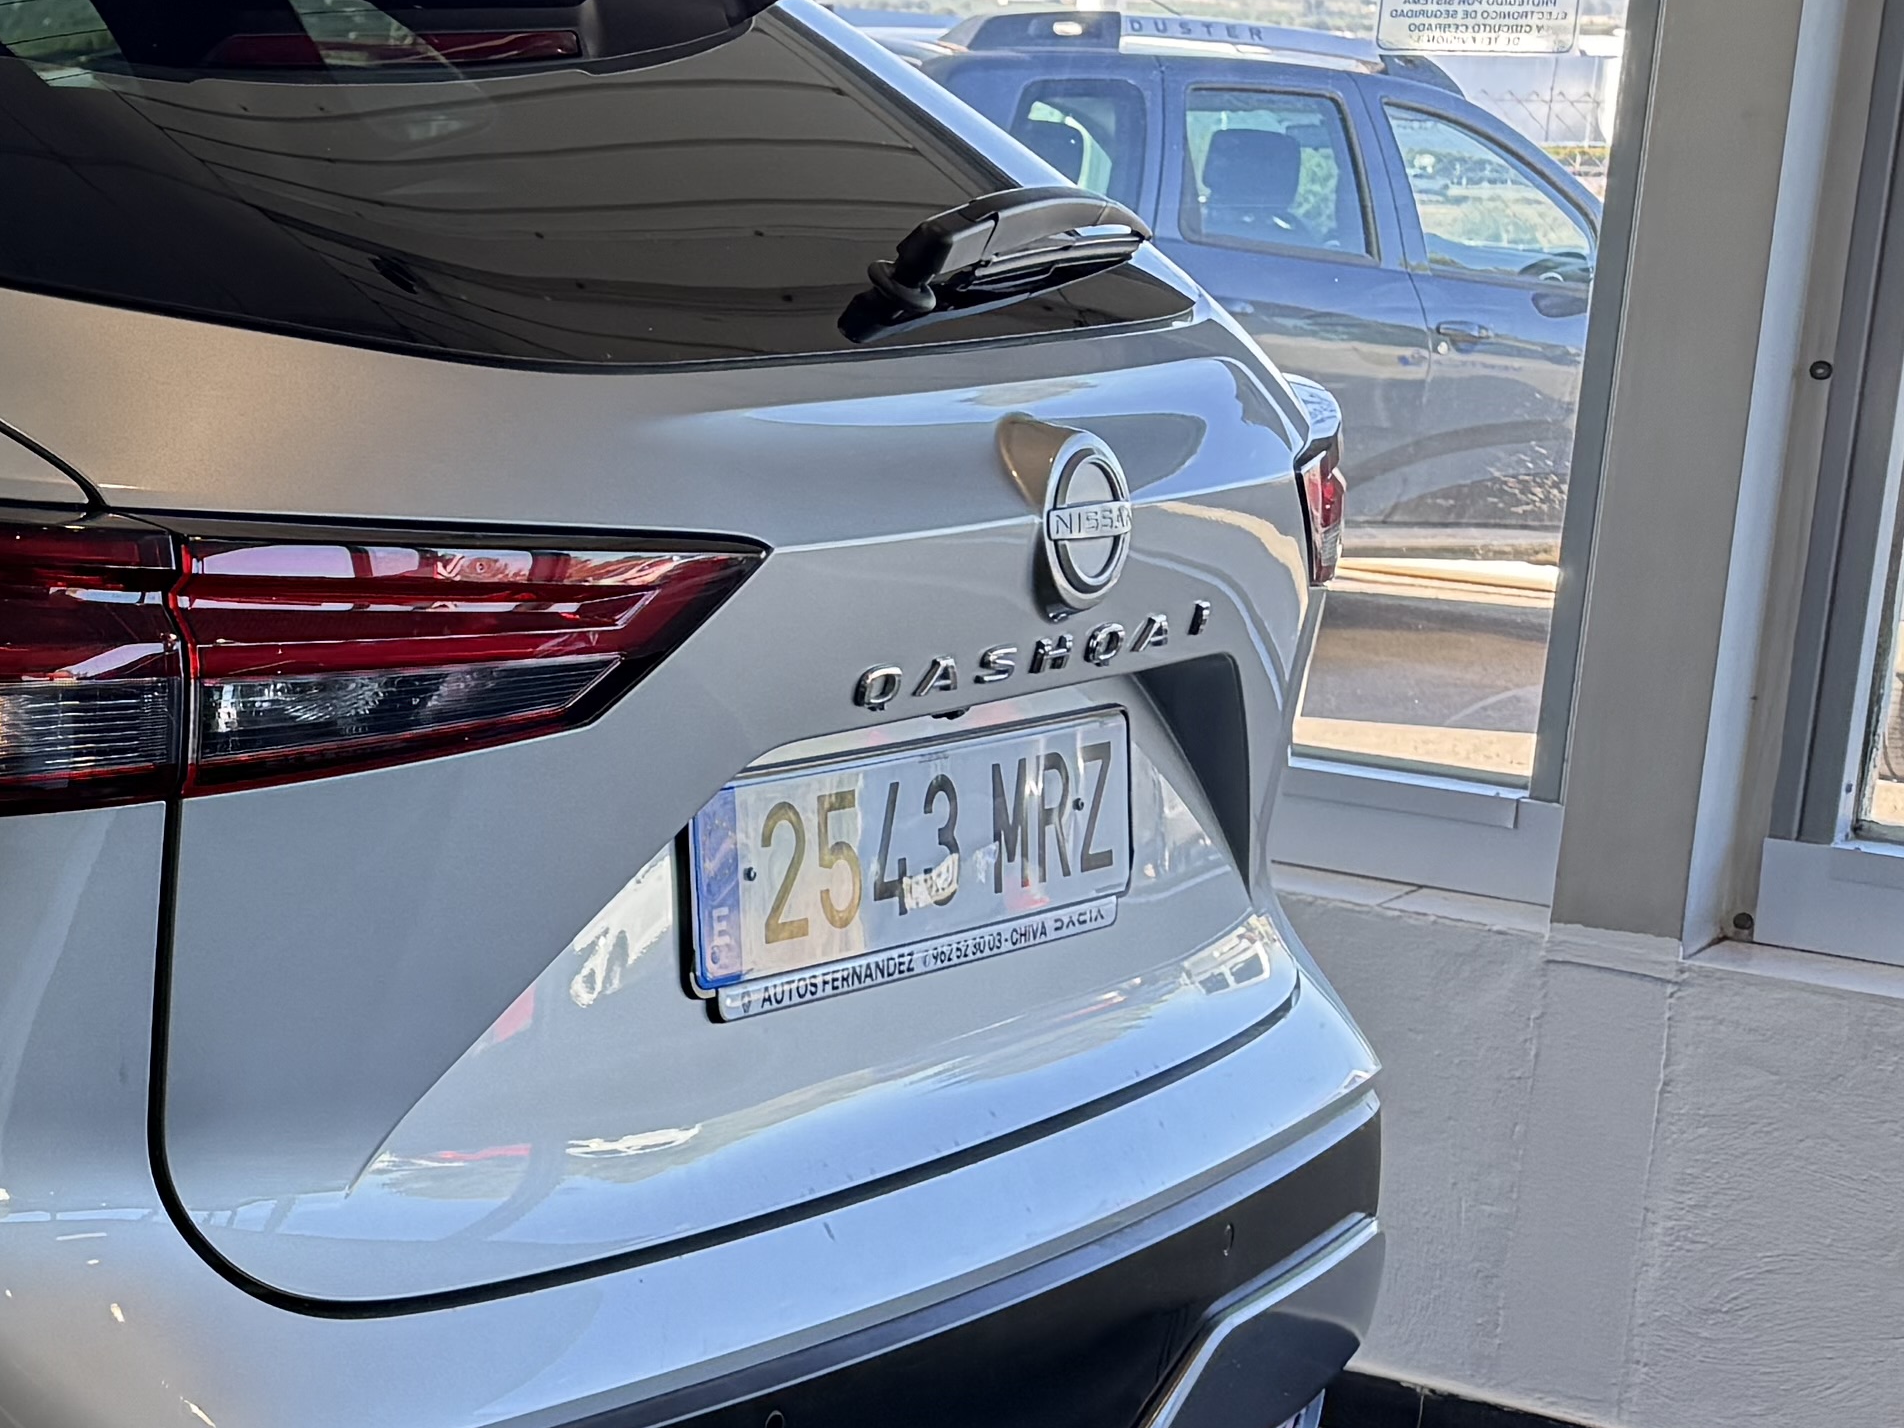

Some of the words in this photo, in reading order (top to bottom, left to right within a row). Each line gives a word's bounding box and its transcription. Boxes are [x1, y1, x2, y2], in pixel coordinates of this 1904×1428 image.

[1129, 18, 1264, 42] DUSTER
[852, 599, 1212, 711] QASHQAI
[760, 773, 961, 945] 2543
[992, 740, 1113, 895] MRZ
[761, 975, 819, 1008] AUTOS
[822, 951, 915, 993] FERNANDEZ
